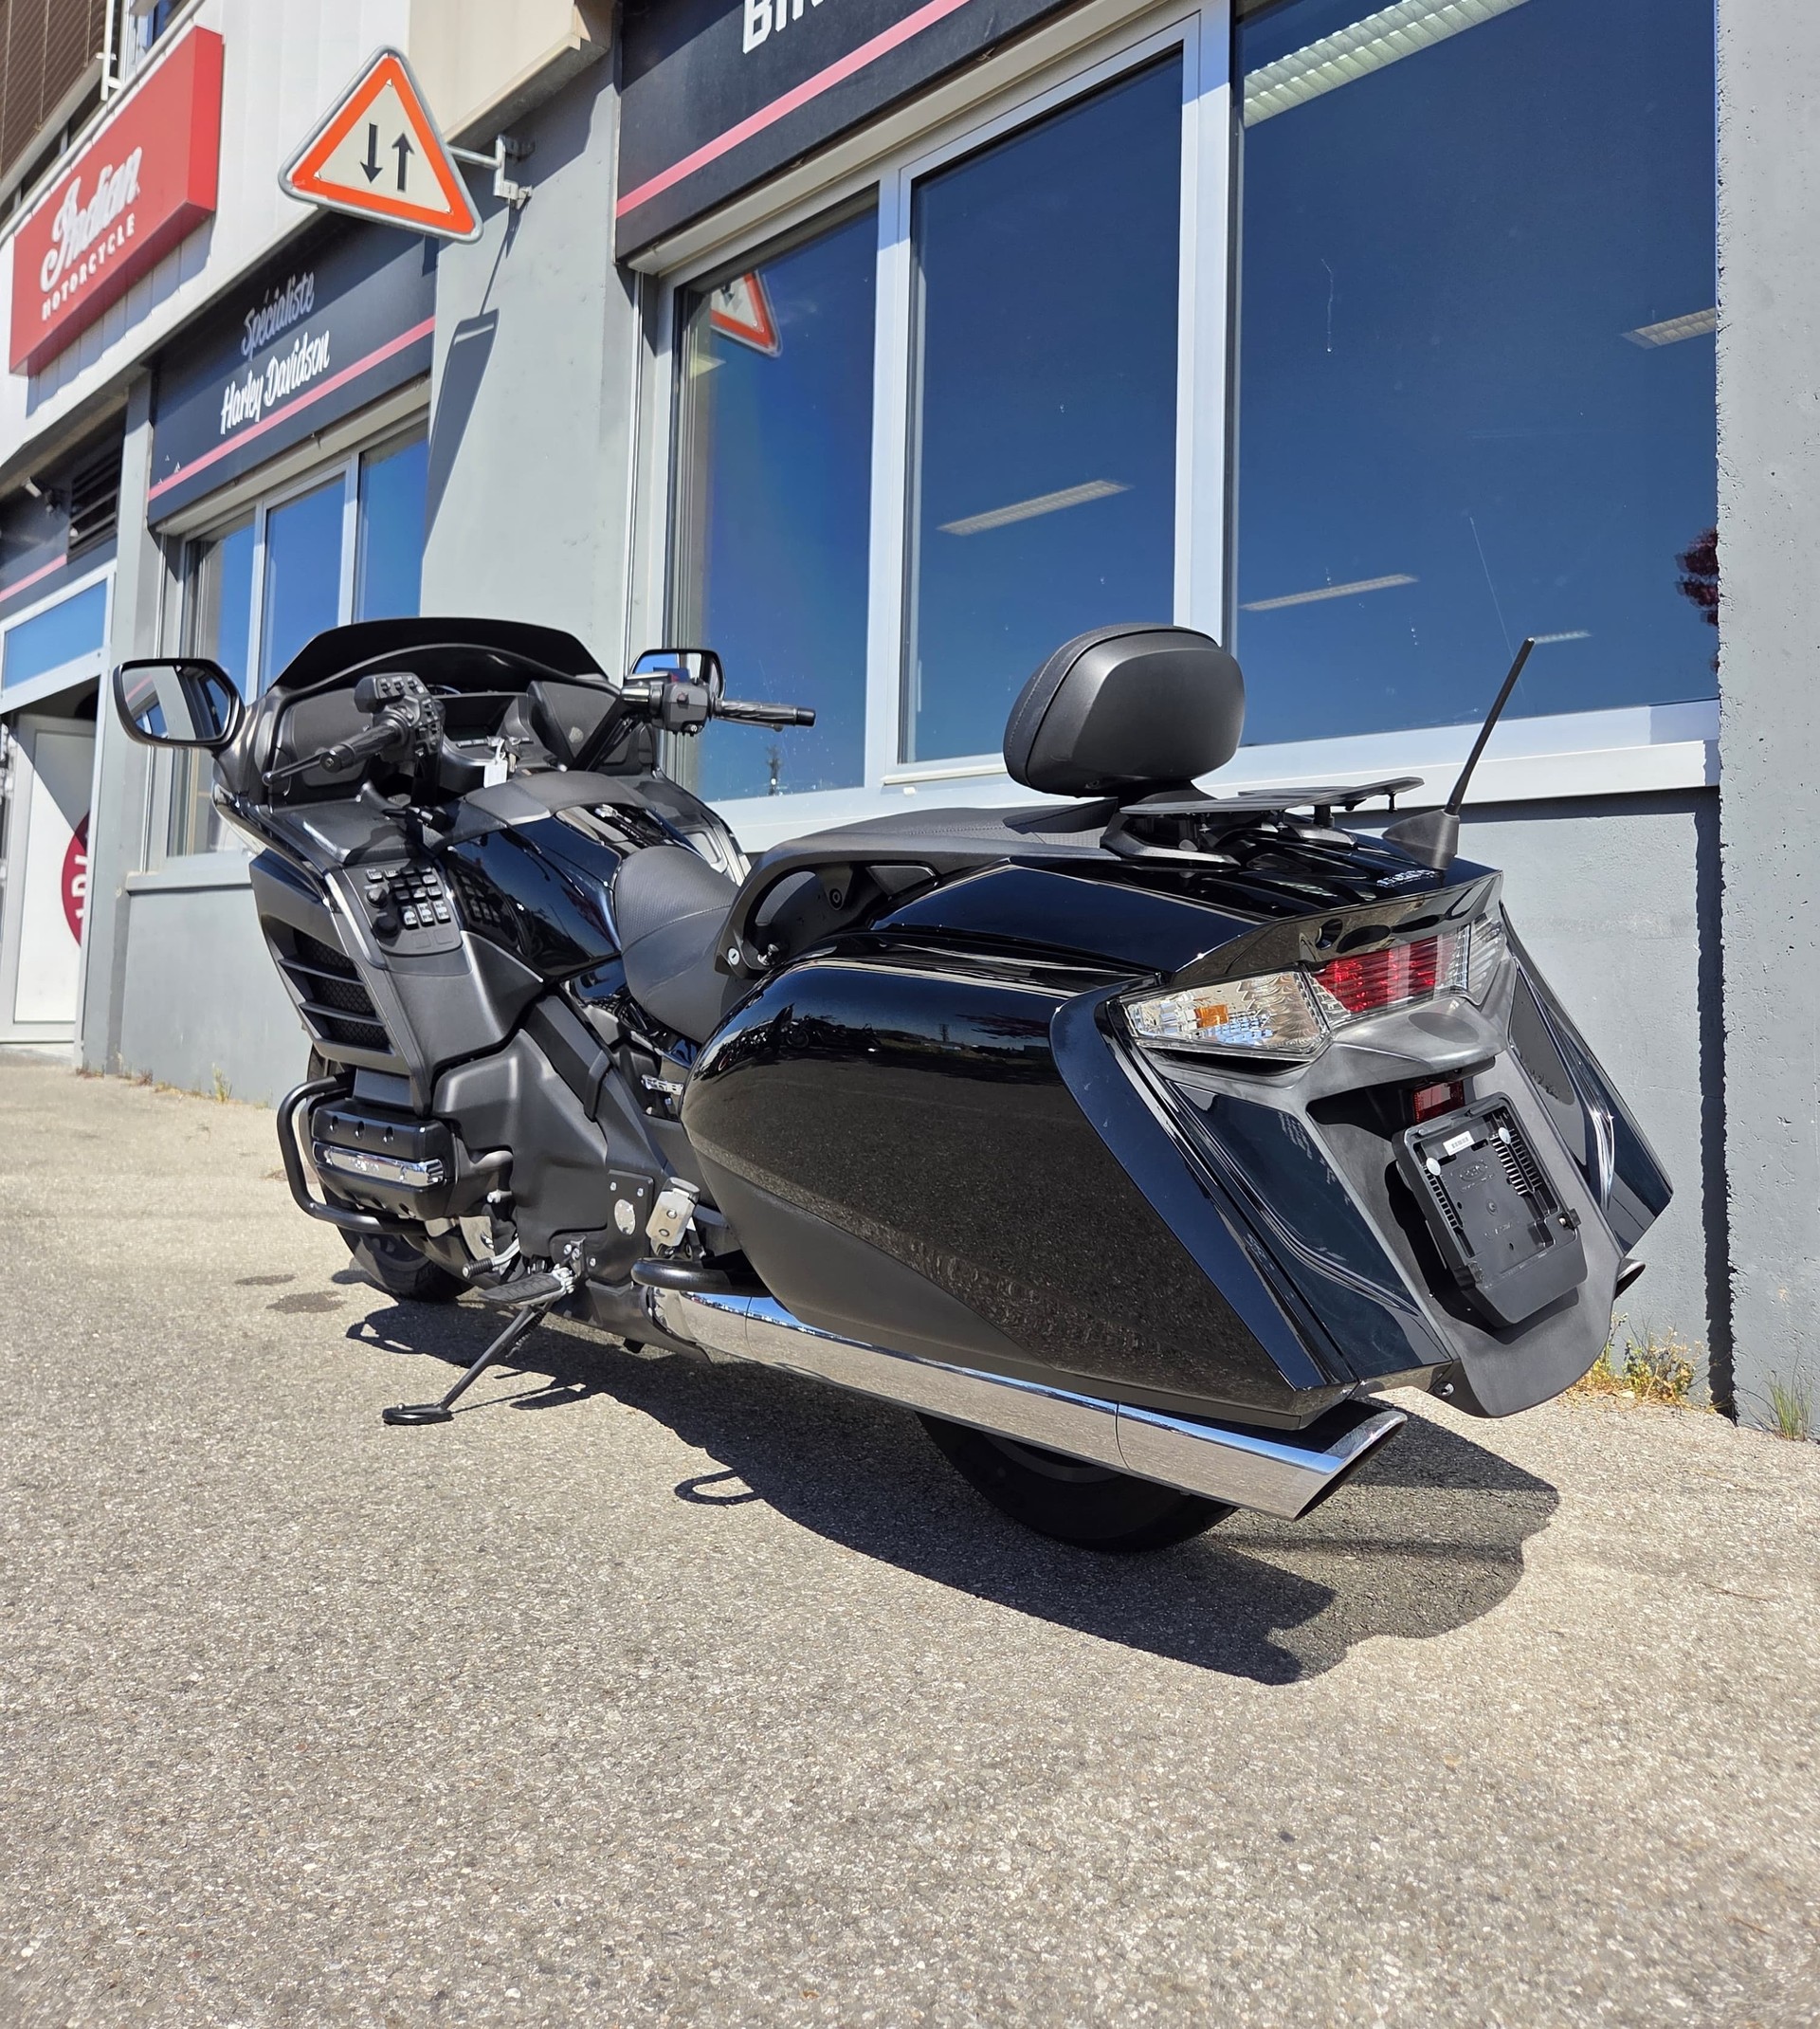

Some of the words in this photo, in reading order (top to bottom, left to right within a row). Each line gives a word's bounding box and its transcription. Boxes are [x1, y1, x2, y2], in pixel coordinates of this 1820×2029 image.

[40, 146, 143, 293] Indian
[42, 211, 136, 321] MOTORCYCLE
[240, 271, 315, 362] Spécialiste
[220, 369, 264, 435] Harley
[264, 329, 330, 407] Davidson
